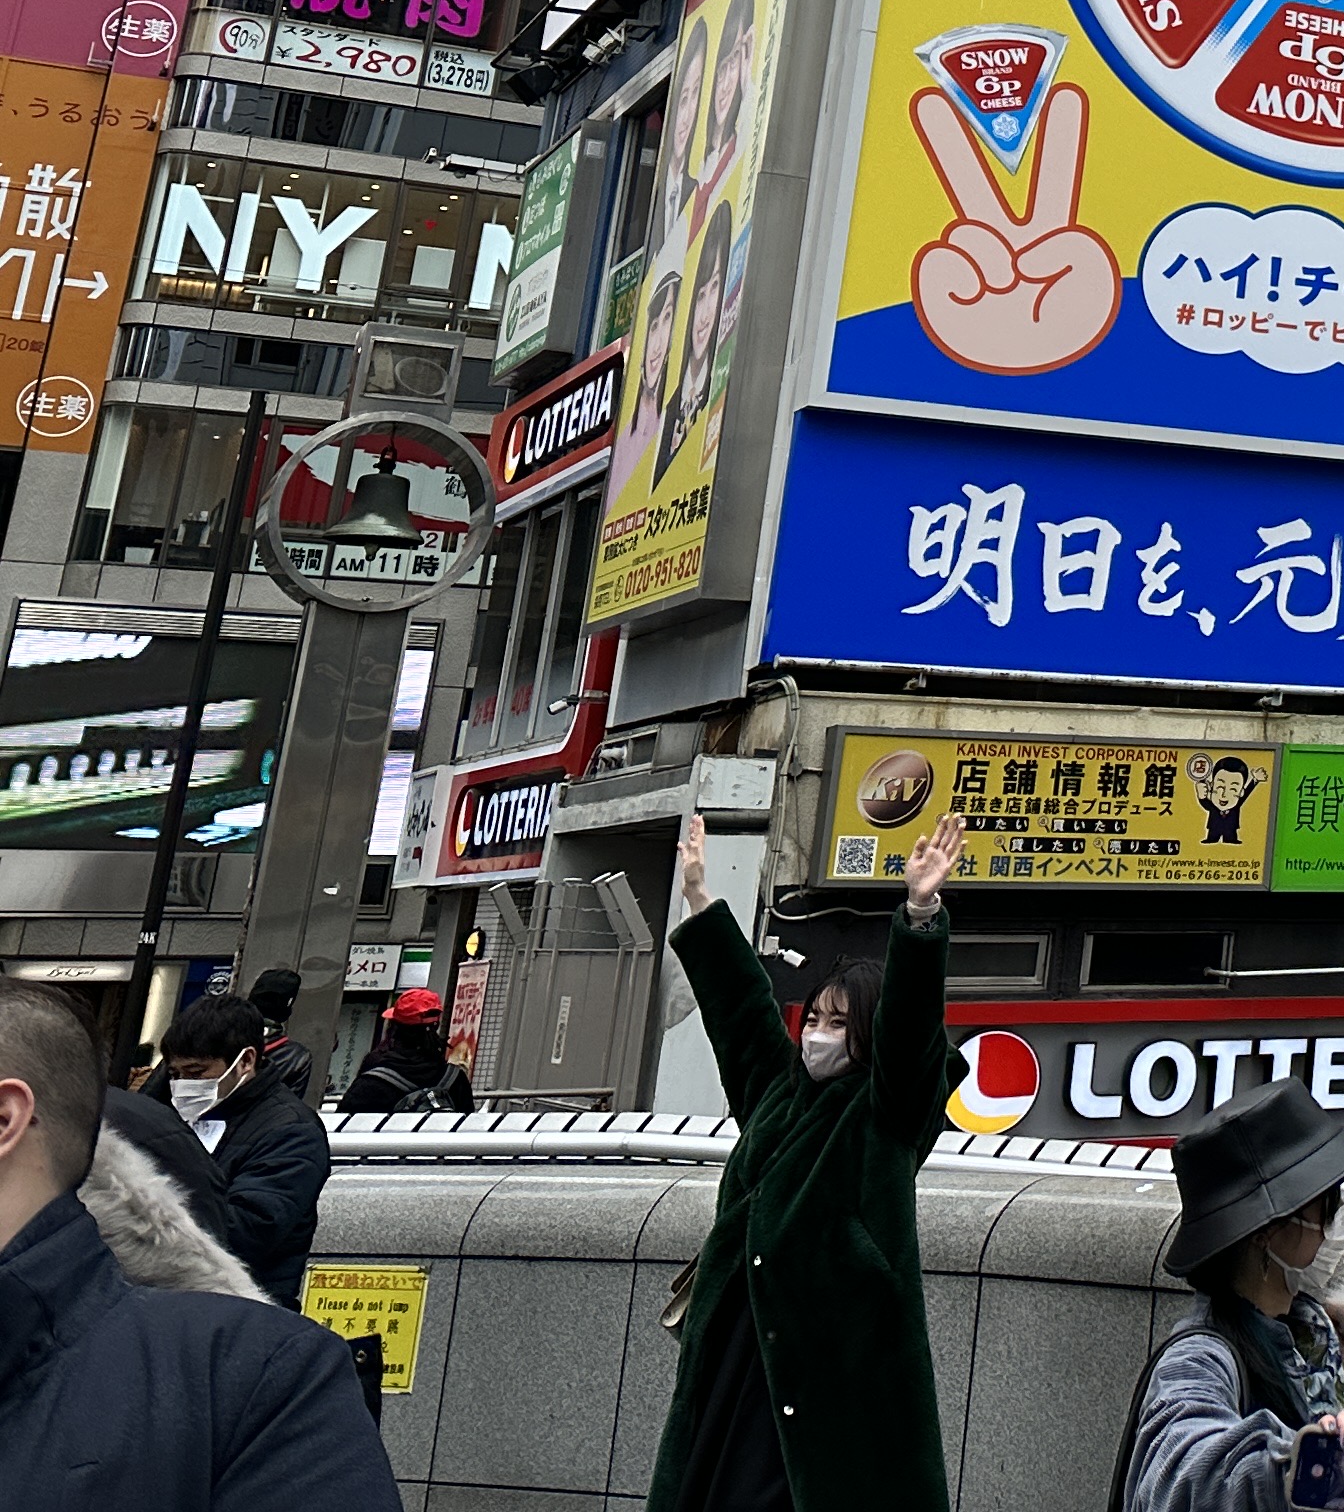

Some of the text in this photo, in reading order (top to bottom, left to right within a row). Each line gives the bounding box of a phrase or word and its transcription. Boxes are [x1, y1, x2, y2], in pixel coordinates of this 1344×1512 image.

[106, 17, 172, 43] 生薬
[283, 25, 381, 48] スタンダード
[434, 51, 465, 65] 税込
[959, 45, 1030, 72] SNOW
[426, 62, 490, 92] (3,278円)
[1286, 73, 1343, 95] BRAND
[979, 93, 1026, 111] CHEESE
[21, 393, 89, 420] 生薬
[526, 368, 616, 466] LOTTERIA
[643, 484, 711, 541] スタッフ大募集
[335, 553, 440, 578] AM 11 時
[624, 545, 701, 600] 0120-951-820
[956, 742, 1180, 763] KANSAI INVEST CORPORATION
[951, 758, 1179, 800] 店舗情報館
[473, 781, 557, 847] LOTTERIA
[948, 795, 1175, 817] 居抜き店舗総合プロデュース
[1051, 819, 1128, 834] 買いたい
[1010, 837, 1181, 855] 貸したい 売りたい
[988, 853, 1129, 879] 関西インベスト
[1137, 869, 1260, 882] TEL 06-6766-2016
[316, 1297, 409, 1314] Please do not jump
